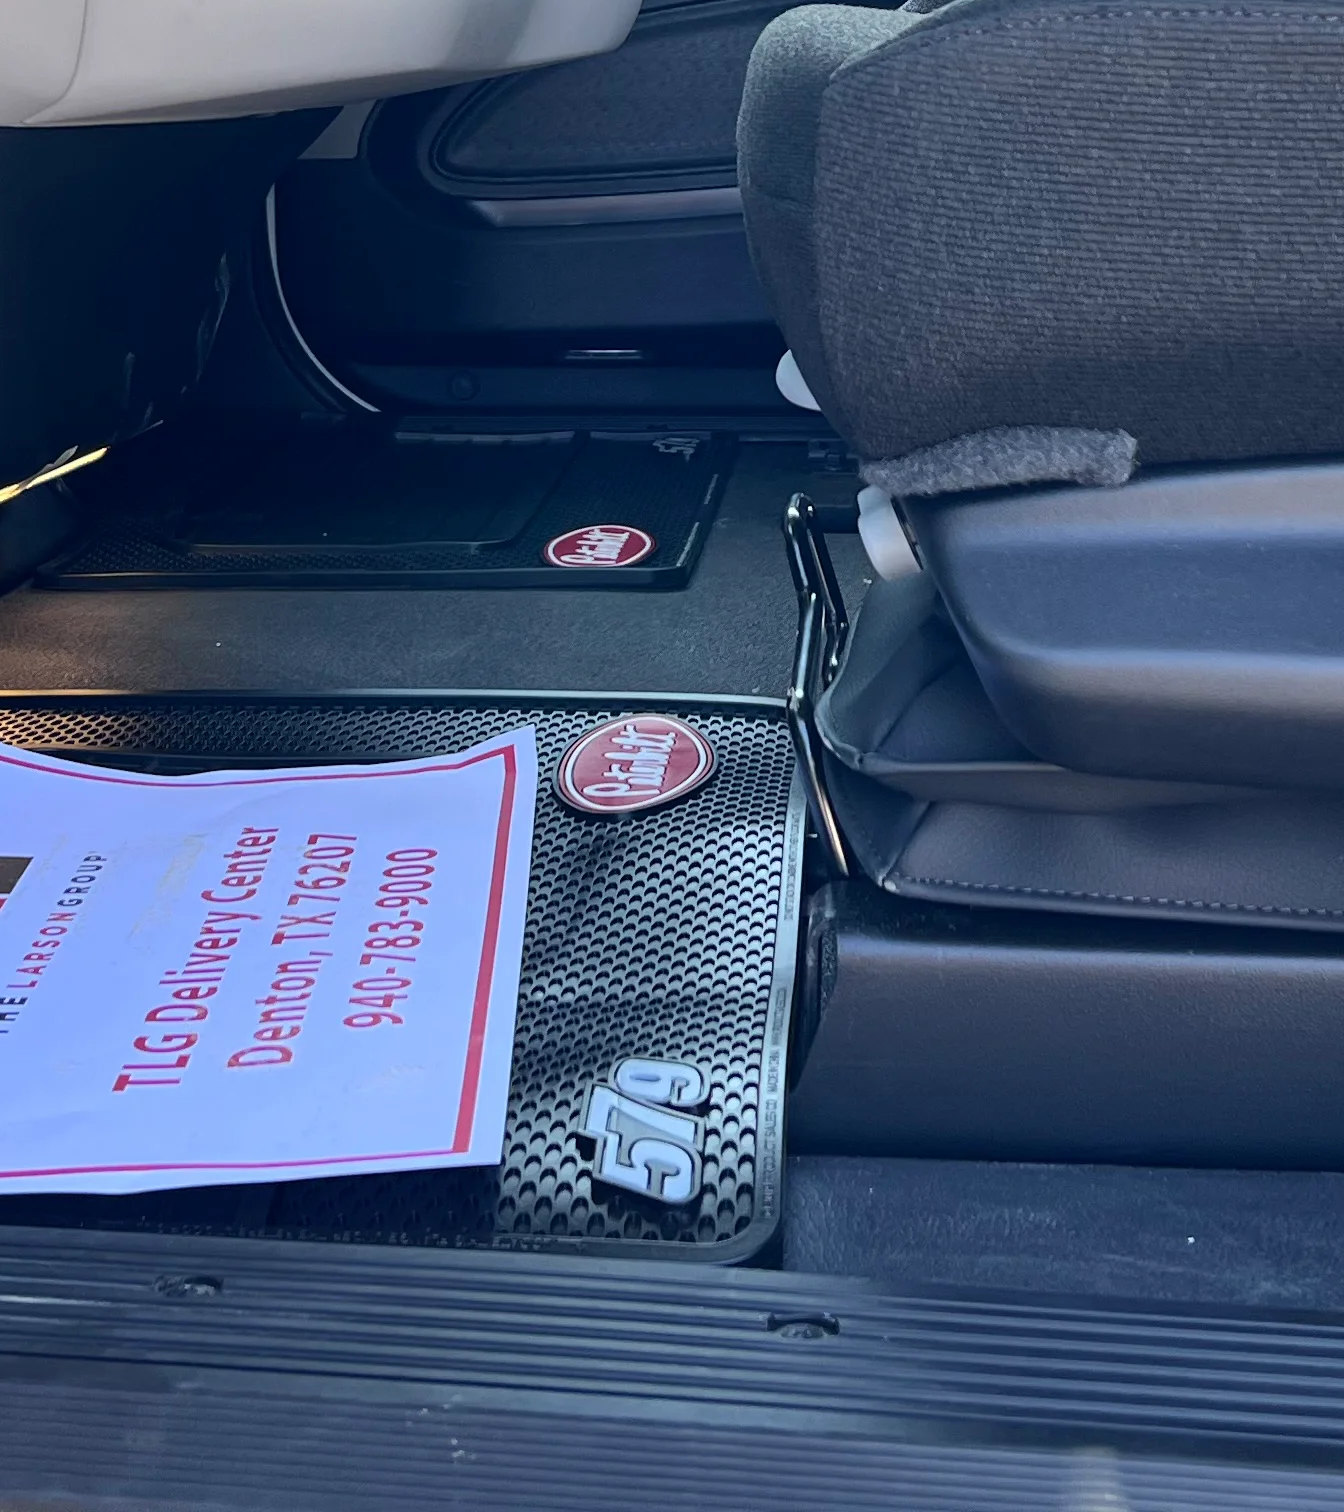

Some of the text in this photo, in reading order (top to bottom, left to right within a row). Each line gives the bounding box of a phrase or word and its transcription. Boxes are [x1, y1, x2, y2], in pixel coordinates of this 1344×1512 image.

[583, 724, 677, 797] Peterbilt
[6, 912, 77, 988] LARSON
[57, 854, 107, 907] GROUP
[112, 827, 280, 1092] TLG Delivery Center
[227, 834, 357, 1068] Denton, TX 76207
[342, 848, 438, 1028] 940-783-9000
[582, 1058, 709, 1203] 579
